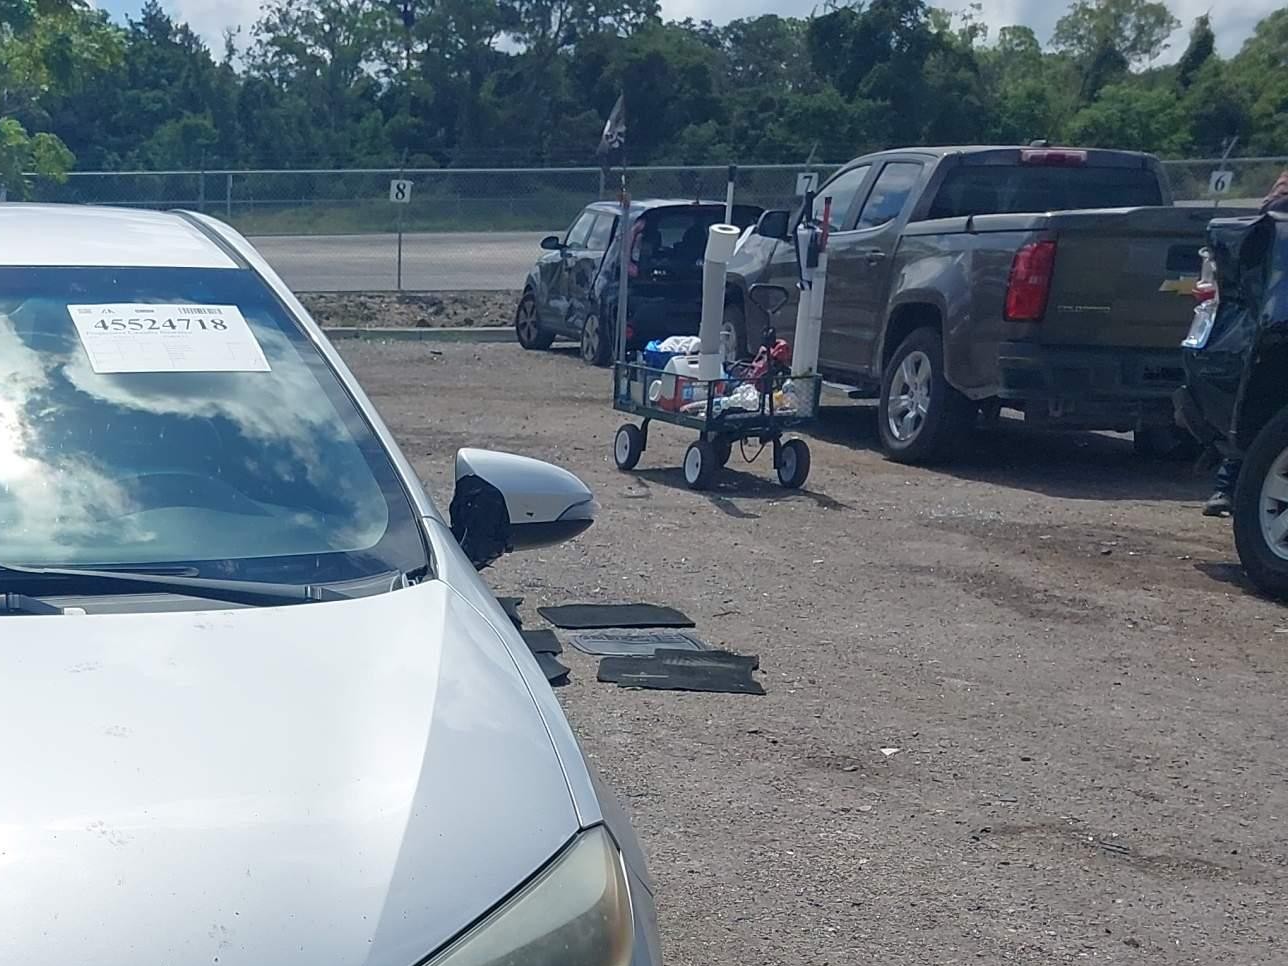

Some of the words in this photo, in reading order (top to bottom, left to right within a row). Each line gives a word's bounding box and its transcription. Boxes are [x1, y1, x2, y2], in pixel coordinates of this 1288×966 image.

[394, 182, 408, 201] 8
[802, 175, 814, 193] 7
[1214, 173, 1226, 192] 6
[93, 318, 229, 332] 45524718
